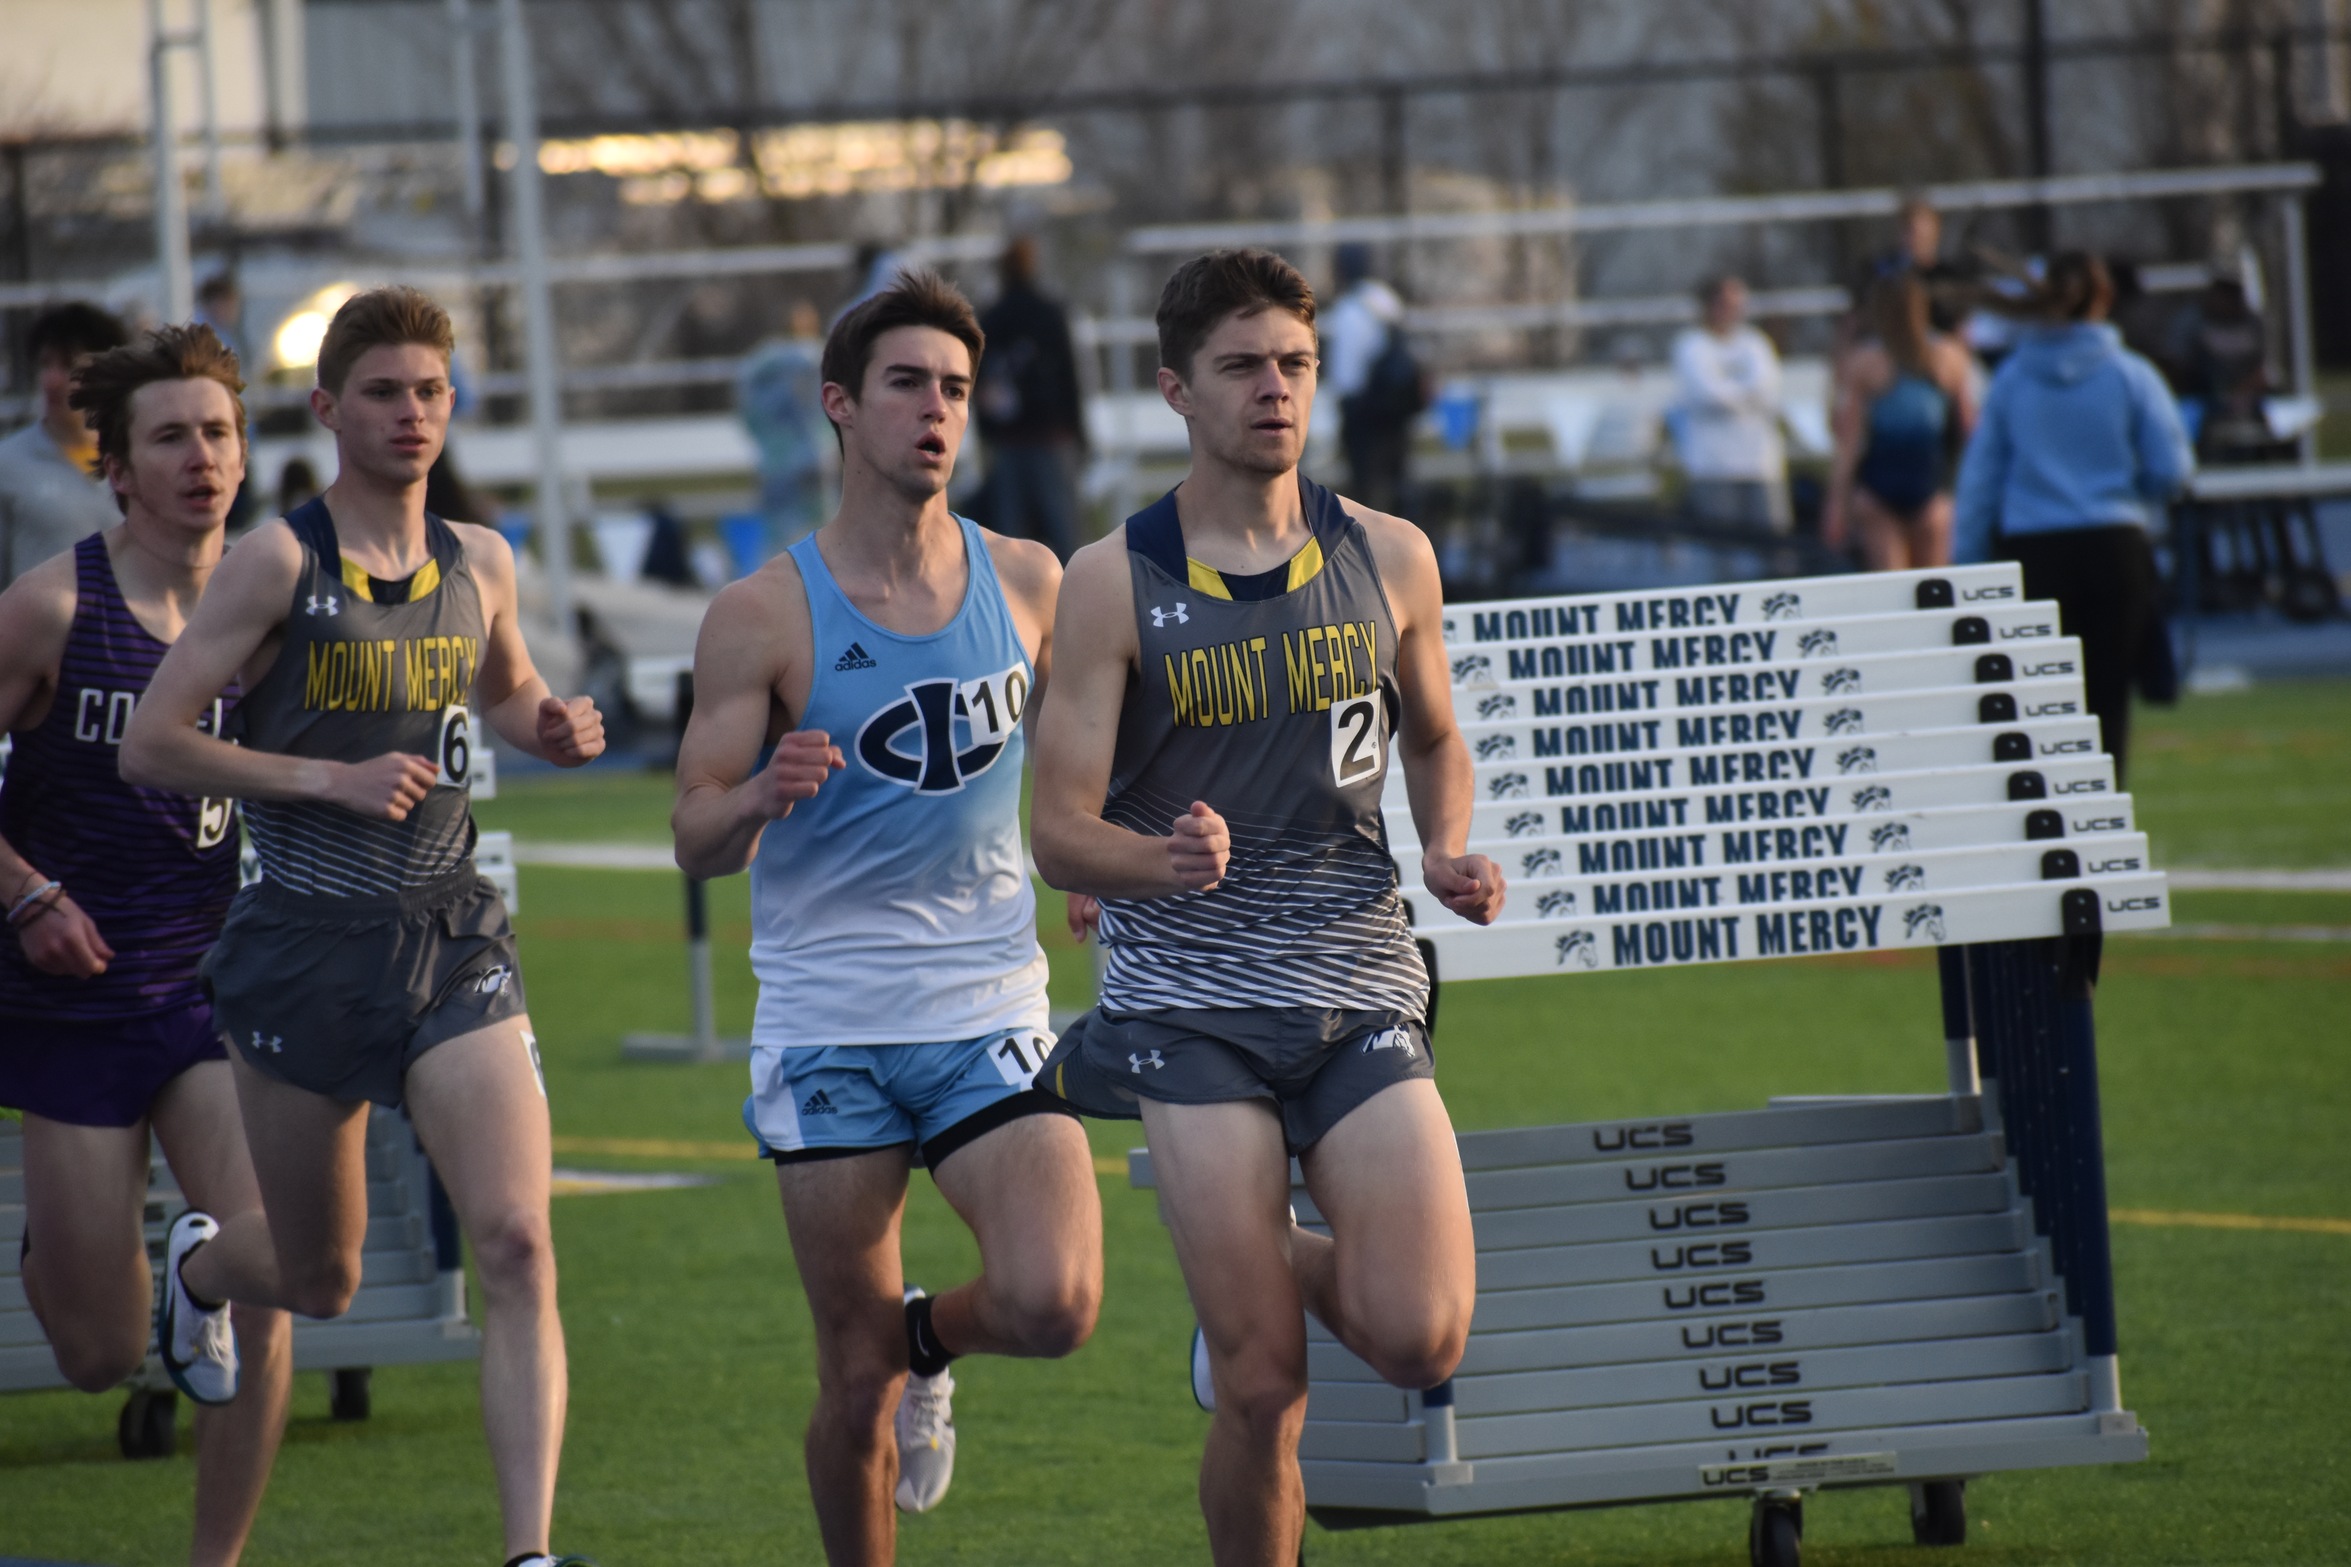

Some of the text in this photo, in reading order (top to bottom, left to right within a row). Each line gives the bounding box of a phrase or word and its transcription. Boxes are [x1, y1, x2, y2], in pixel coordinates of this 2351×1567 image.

[1962, 586, 2015, 601] UCS
[1473, 594, 1740, 641] MOUNT MERCY
[1999, 624, 2052, 639] UCS
[834, 657, 877, 672] adidas
[1508, 631, 1776, 680] MOUNT MERCY
[2023, 661, 2074, 676] UCS
[304, 635, 477, 712] MOUNT MERCY
[1164, 621, 1379, 728] MOUNT MERCY
[971, 670, 1028, 734] 10
[1533, 669, 1799, 717] MOUNT MERCY
[2025, 702, 2077, 716] UCS
[443, 711, 469, 784] 6
[1337, 700, 1376, 781] 2
[1533, 710, 1801, 757] MOUNT MERCY
[2040, 740, 2092, 754] UCS
[1546, 748, 1814, 796] MOUNT MERCY
[2054, 779, 2106, 794] UCS
[1561, 787, 1830, 834] MOUNT MERCY
[2073, 817, 2126, 832] UCS
[1579, 824, 1847, 874] MOUNT MERCY
[2088, 858, 2141, 873] UCS
[1593, 866, 1863, 914] MOUNT MERCY
[2108, 897, 2160, 912] UCS
[1613, 905, 1882, 966] MOUNT MERCY
[801, 1104, 838, 1116] adidas
[1594, 1123, 1693, 1151] UCS
[1625, 1162, 1726, 1191] UCS
[1649, 1202, 1749, 1230] UCS
[1652, 1241, 1753, 1270] UCS
[1664, 1281, 1765, 1309] UCS
[1682, 1320, 1783, 1348] UCS
[1700, 1361, 1800, 1390] UCS
[1712, 1400, 1812, 1429] UCS
[1703, 1466, 1769, 1486] UCS
